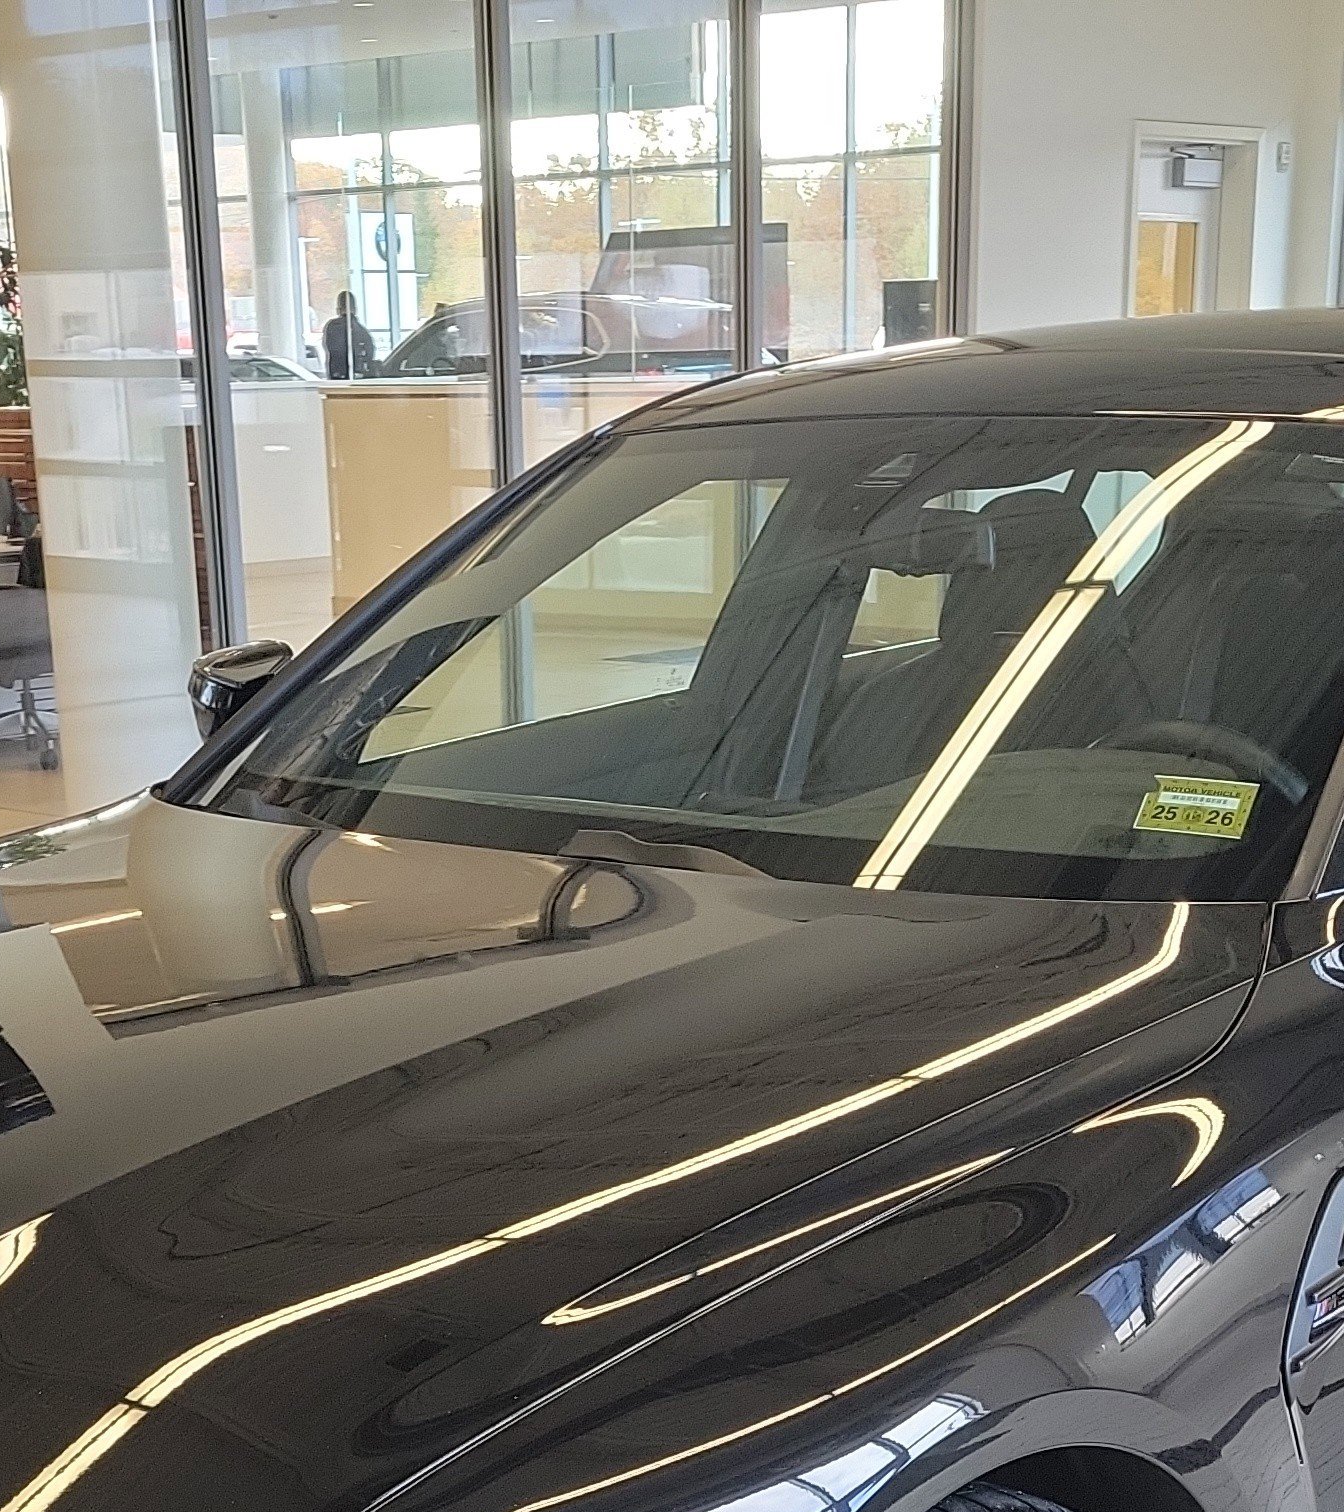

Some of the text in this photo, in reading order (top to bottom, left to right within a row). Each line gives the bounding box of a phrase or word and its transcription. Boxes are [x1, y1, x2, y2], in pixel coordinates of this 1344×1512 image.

[1163, 785, 1242, 798] MOTOR VEHICLE
[1151, 804, 1235, 826] 25 26
